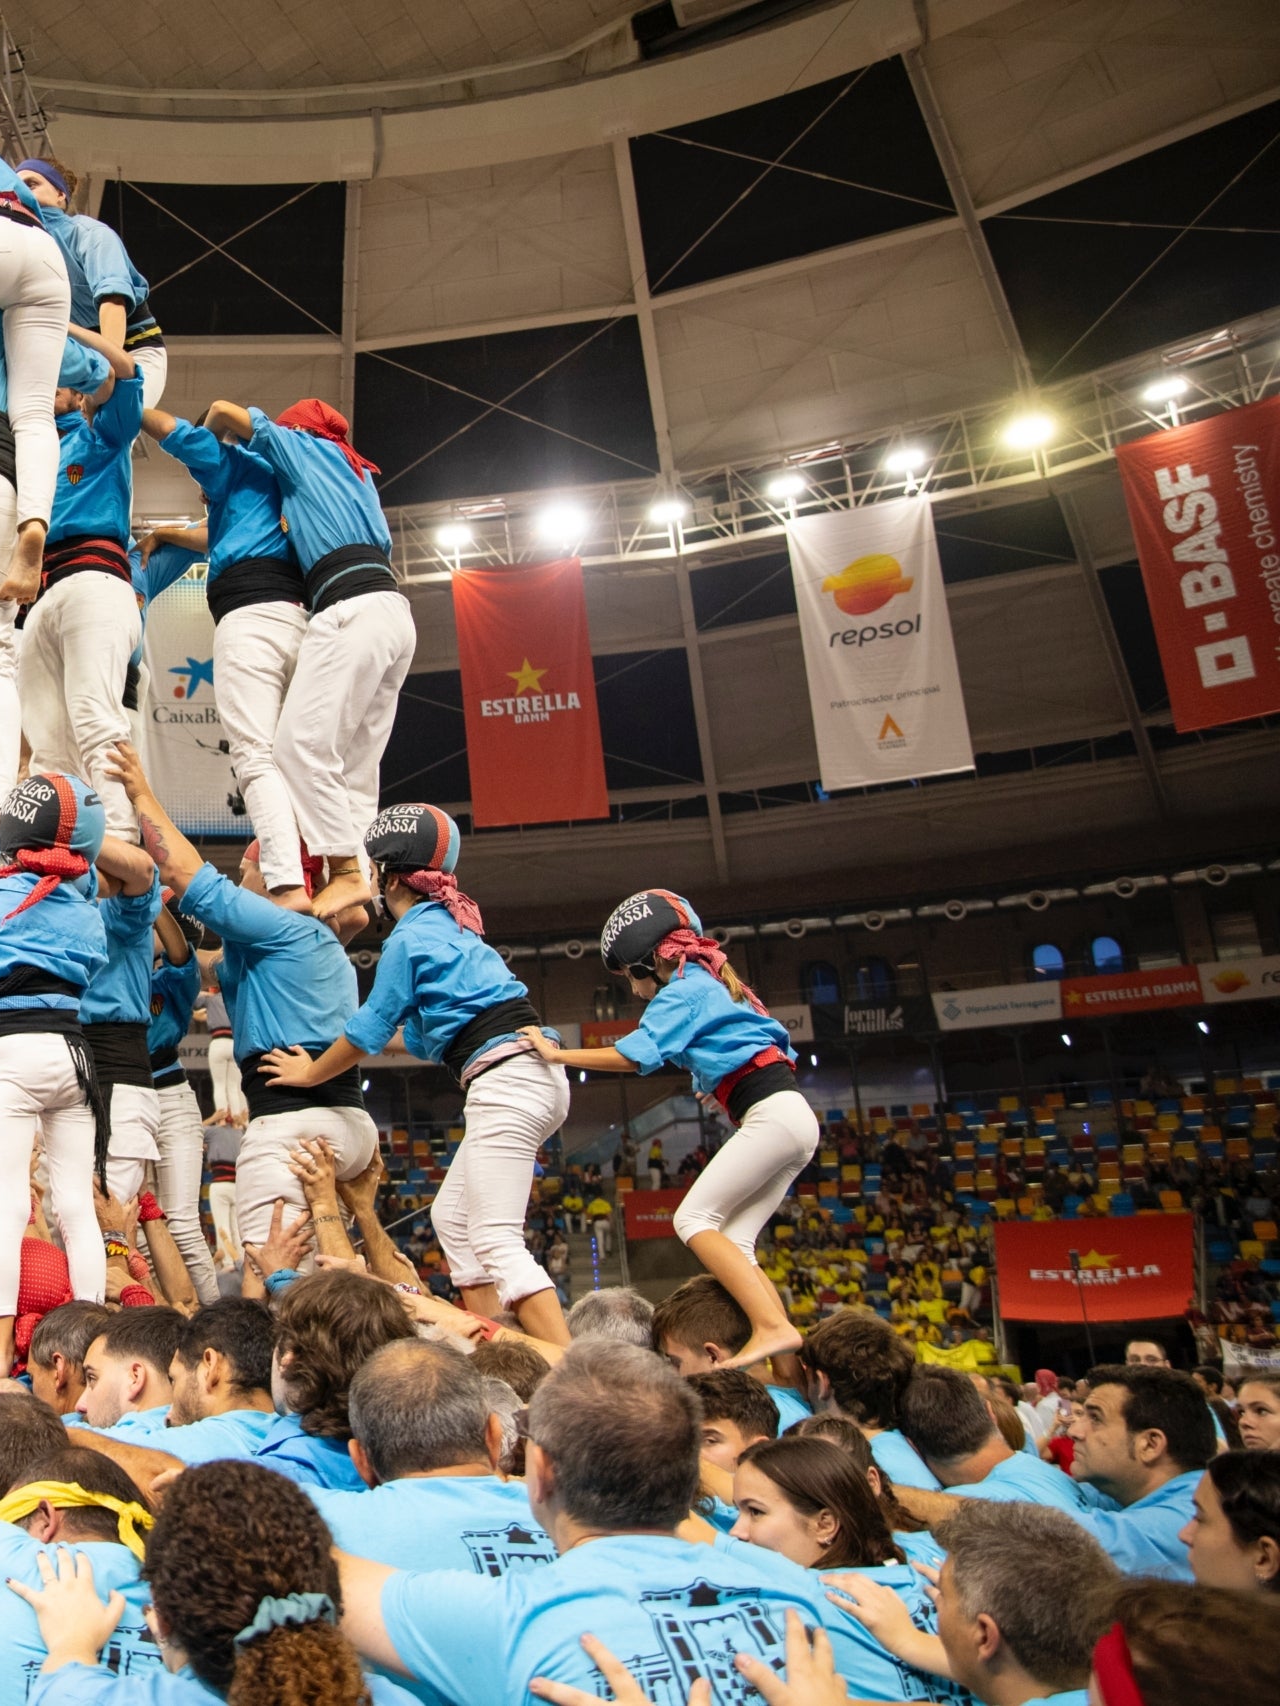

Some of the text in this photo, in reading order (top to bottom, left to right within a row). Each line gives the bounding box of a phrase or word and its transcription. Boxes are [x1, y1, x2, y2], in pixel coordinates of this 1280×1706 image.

[1232, 445, 1276, 549] chemistry
[1154, 463, 1237, 609] BASF
[829, 613, 922, 648] repsol
[480, 692, 582, 717] ESTRELLA
[514, 712, 550, 724] DAMM
[1084, 981, 1198, 1004] ESTRELLA DAMM
[1028, 1264, 1161, 1281] ESTRELLA
